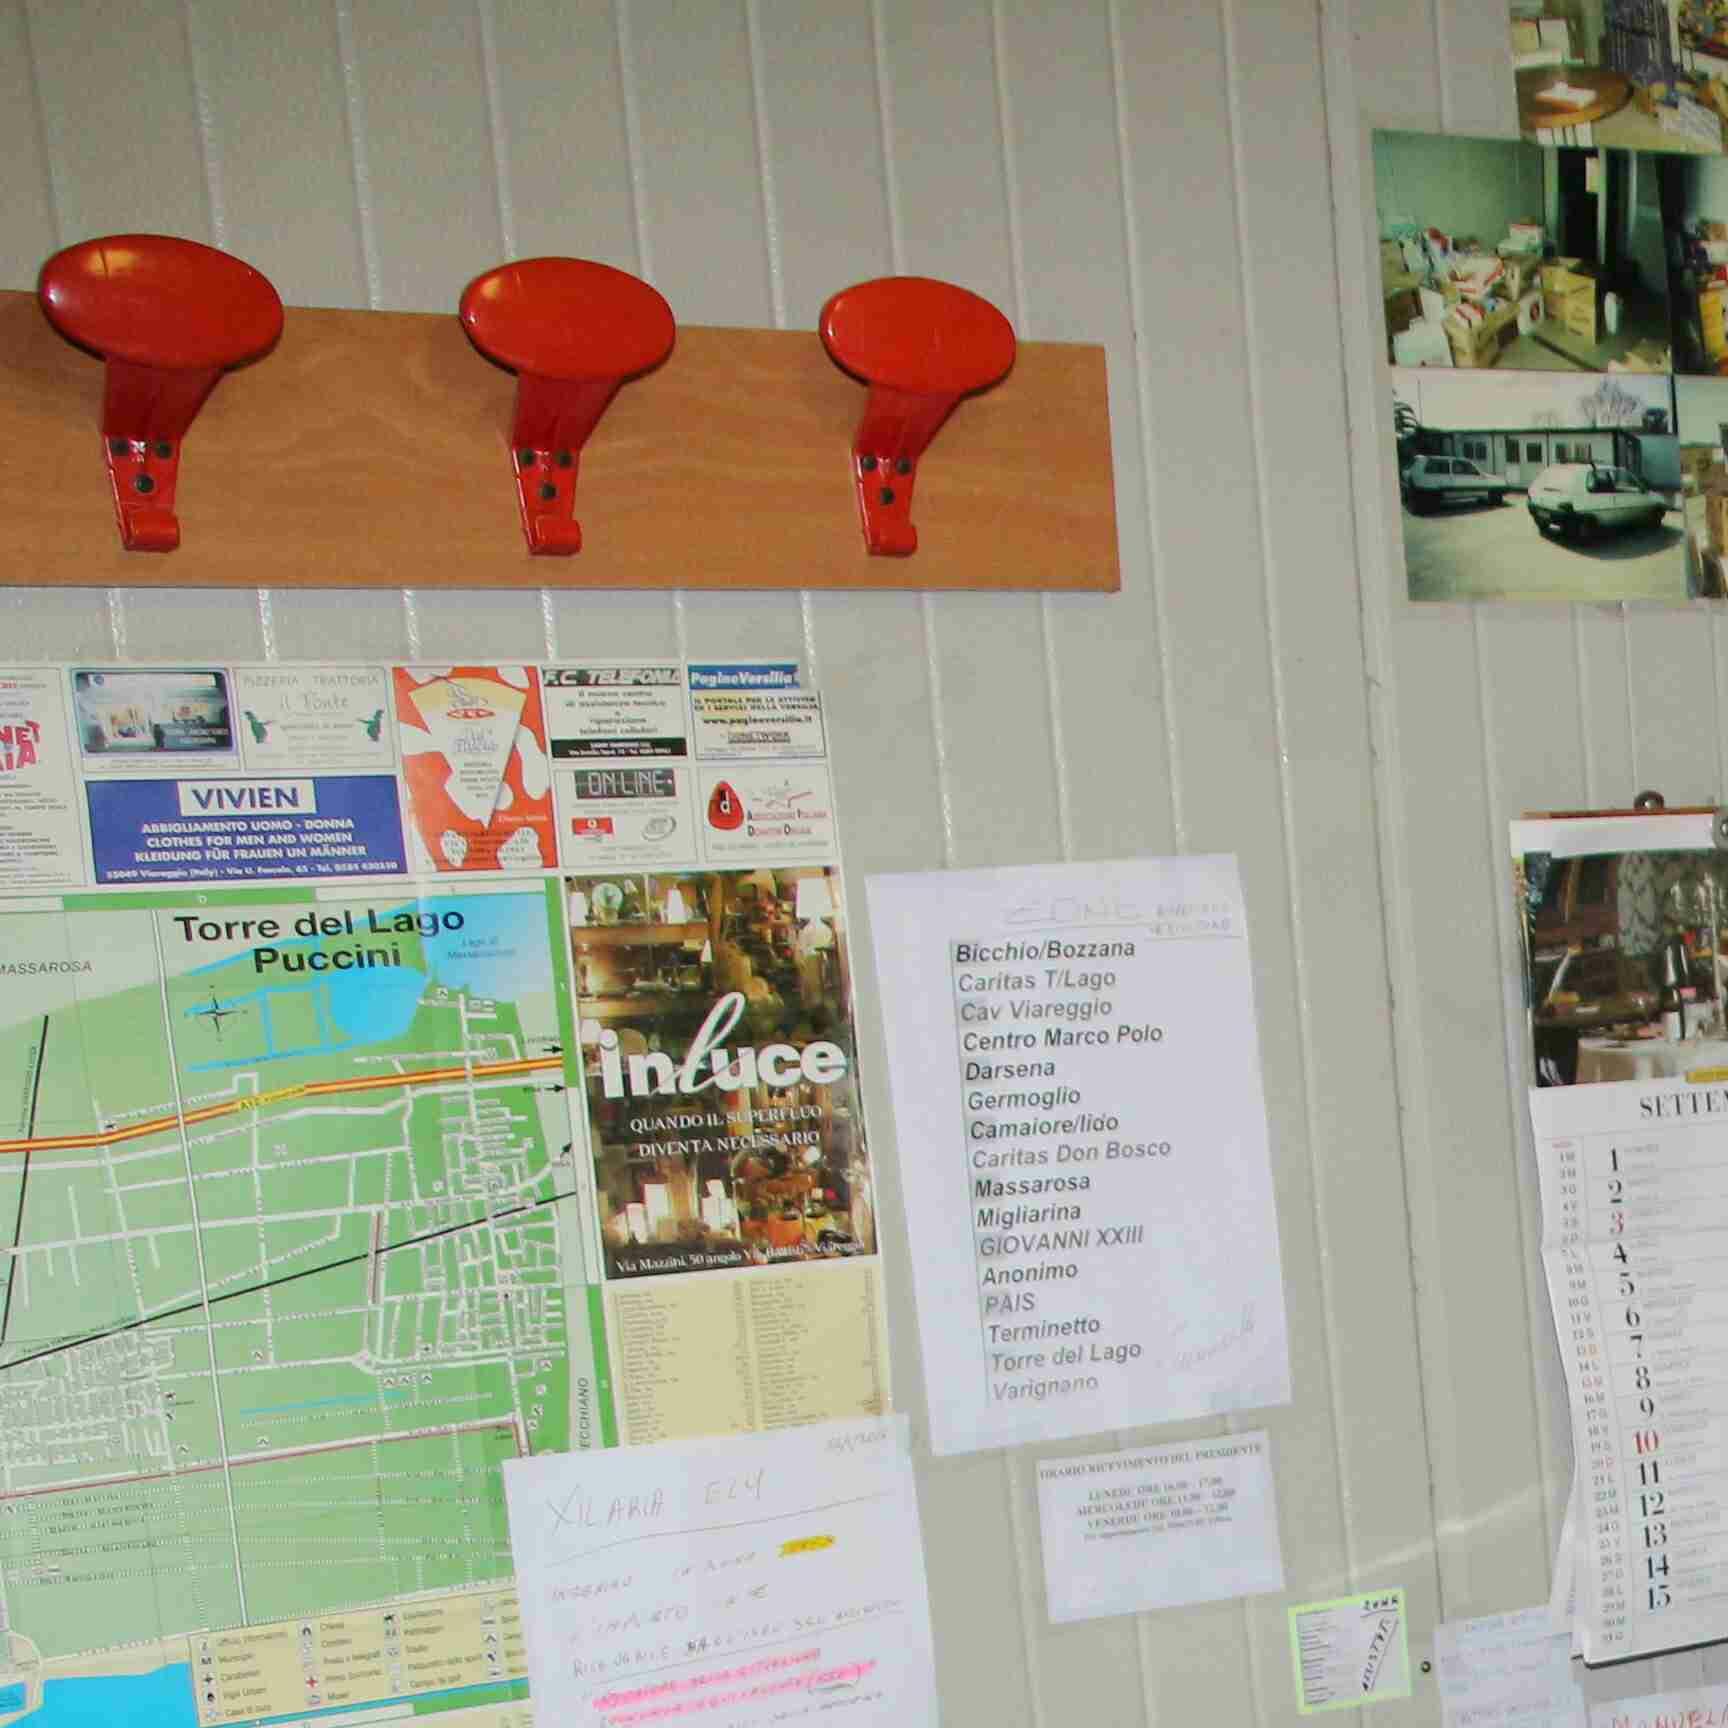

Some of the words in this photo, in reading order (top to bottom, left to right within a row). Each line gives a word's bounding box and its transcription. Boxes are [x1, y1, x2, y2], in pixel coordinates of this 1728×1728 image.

[191, 785, 300, 811] VIVIEN
[141, 819, 248, 835] ABBIGLIAMENTO
[251, 819, 292, 833] UOMO
[304, 817, 354, 832] DONNA
[135, 847, 202, 863] KLEIDUNG
[205, 845, 230, 862] FÜR
[233, 845, 284, 861] FRAUEN
[287, 845, 307, 859] UN
[310, 842, 367, 859] MÄNNER
[147, 833, 203, 849] CLOTHES
[206, 833, 231, 847] FOR
[236, 832, 264, 846] MEN
[268, 831, 296, 845] AND
[300, 830, 353, 845] WOMEN
[174, 914, 281, 943] Torre
[295, 911, 354, 938] del
[367, 908, 466, 940] Lago
[254, 942, 402, 974] Puccini
[955, 938, 1136, 963] Bicchio/Bozzana
[958, 970, 1036, 993] Caritas
[1043, 967, 1117, 993] T/Lago
[960, 1000, 1002, 1023] Cav
[1010, 998, 1113, 1024] Viareggio
[962, 1029, 1037, 1052] Centro
[1044, 1027, 1110, 1048] Marco
[1117, 1023, 1163, 1045] Polo
[965, 1059, 1056, 1082] Darsena
[967, 1086, 1081, 1113] Germoglio
[629, 1112, 704, 1135] QUANDO
[725, 1104, 823, 1127] SUPERFLUO
[970, 1113, 1119, 1141] Camaiore/lido
[638, 1138, 713, 1159] DIVENTA
[717, 1129, 821, 1153] NECESSARIO
[972, 1146, 1049, 1170] Caritas
[1056, 1143, 1098, 1164] Don
[1105, 1138, 1171, 1160] Bosco
[1608, 1148, 1620, 1172] 1
[974, 1173, 1091, 1199] Massarosa
[1608, 1181, 1624, 1205] 2
[976, 1202, 1081, 1230] Migliarina
[1609, 1211, 1625, 1235] 3
[979, 1229, 1091, 1257] GIOVANNI
[1096, 1224, 1145, 1247] XXIII
[1612, 1241, 1629, 1265] 4
[616, 1258, 638, 1275] Via
[981, 1260, 1079, 1287] Anonimo
[1618, 1272, 1636, 1297] 5
[984, 1291, 1036, 1315] PAIS
[1624, 1304, 1642, 1328] 6
[987, 1316, 1101, 1345] Terminetto
[991, 1350, 1046, 1375] Torre
[1052, 1344, 1085, 1367] del
[1089, 1340, 1143, 1367] Lago
[1629, 1334, 1644, 1360] 7
[993, 1373, 1099, 1404] Varignano
[1634, 1366, 1652, 1391] 8
[1639, 1396, 1656, 1420] 9
[1632, 1429, 1660, 1455] 10
[1637, 1460, 1661, 1486] 11
[1639, 1491, 1666, 1517] 12
[1642, 1523, 1669, 1549] 13
[1645, 1553, 1672, 1580] 14
[1646, 1584, 1673, 1611] 15
